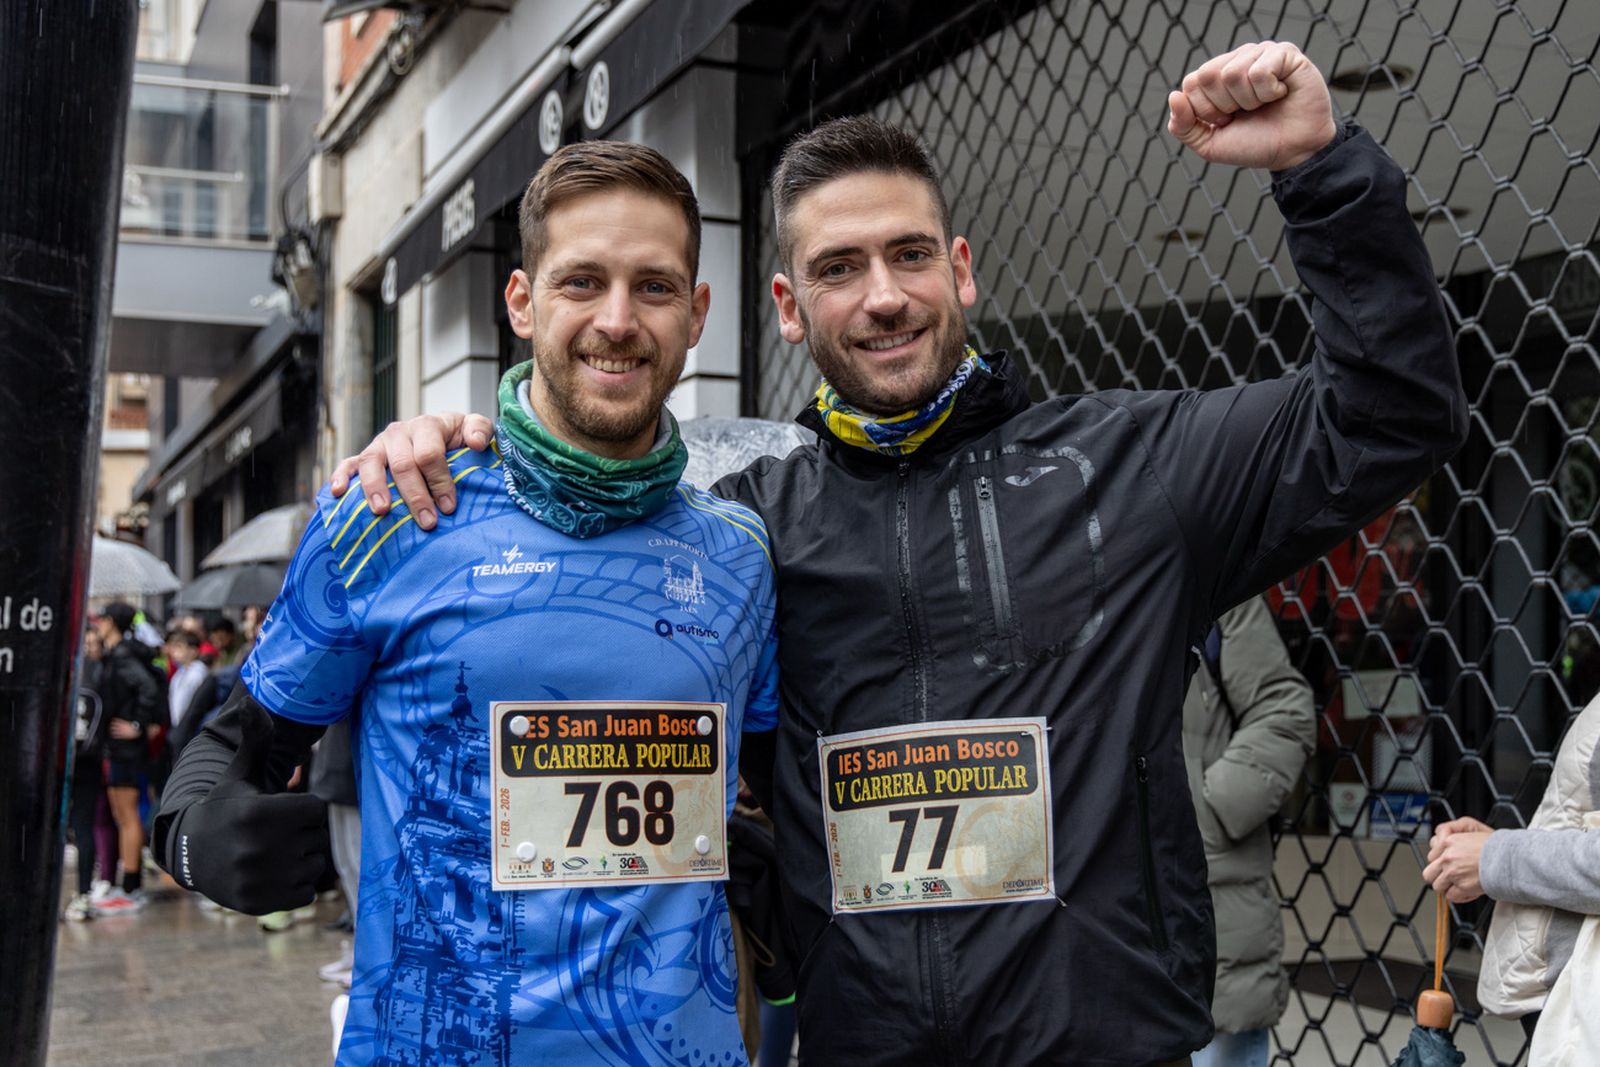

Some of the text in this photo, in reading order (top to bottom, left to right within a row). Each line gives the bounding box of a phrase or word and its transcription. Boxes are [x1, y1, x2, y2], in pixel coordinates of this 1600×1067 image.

[472, 560, 557, 577] TEAMERGY
[0, 595, 53, 632] l de
[676, 624, 720, 640] autismo
[519, 714, 704, 738] ES San Juan Bosc
[511, 743, 711, 770] V CARRERA POPULAR
[838, 738, 1019, 775] IES San Juan Bosco
[500, 787, 510, 810] 2026
[835, 765, 1028, 804] V CARRERA POPULAR
[564, 780, 675, 848] 768
[889, 804, 960, 873] 77
[182, 835, 194, 887] KIPRUN
